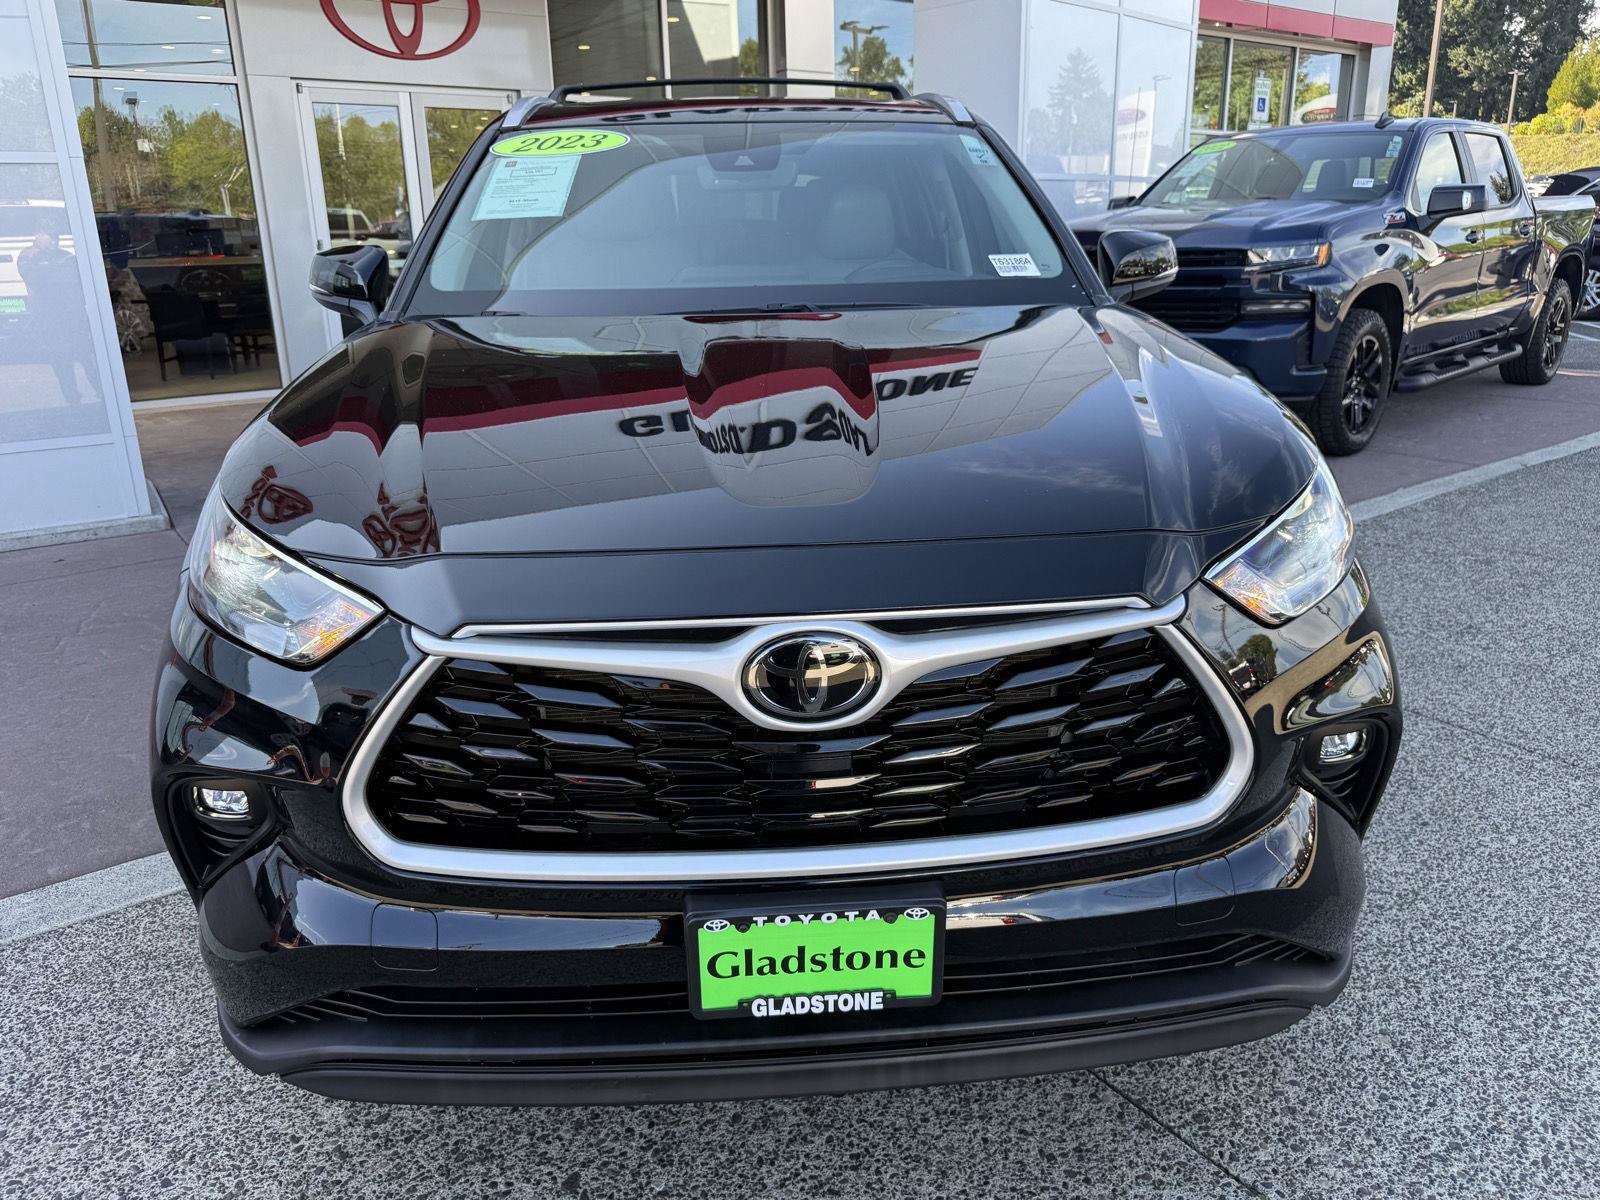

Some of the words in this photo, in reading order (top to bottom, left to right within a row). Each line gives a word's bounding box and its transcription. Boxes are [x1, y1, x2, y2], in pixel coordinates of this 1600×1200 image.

[511, 133, 609, 154] 2023
[752, 909, 881, 928] TOYOTA
[706, 945, 926, 980] Gladstone
[751, 991, 884, 1018] GLADSTONE
